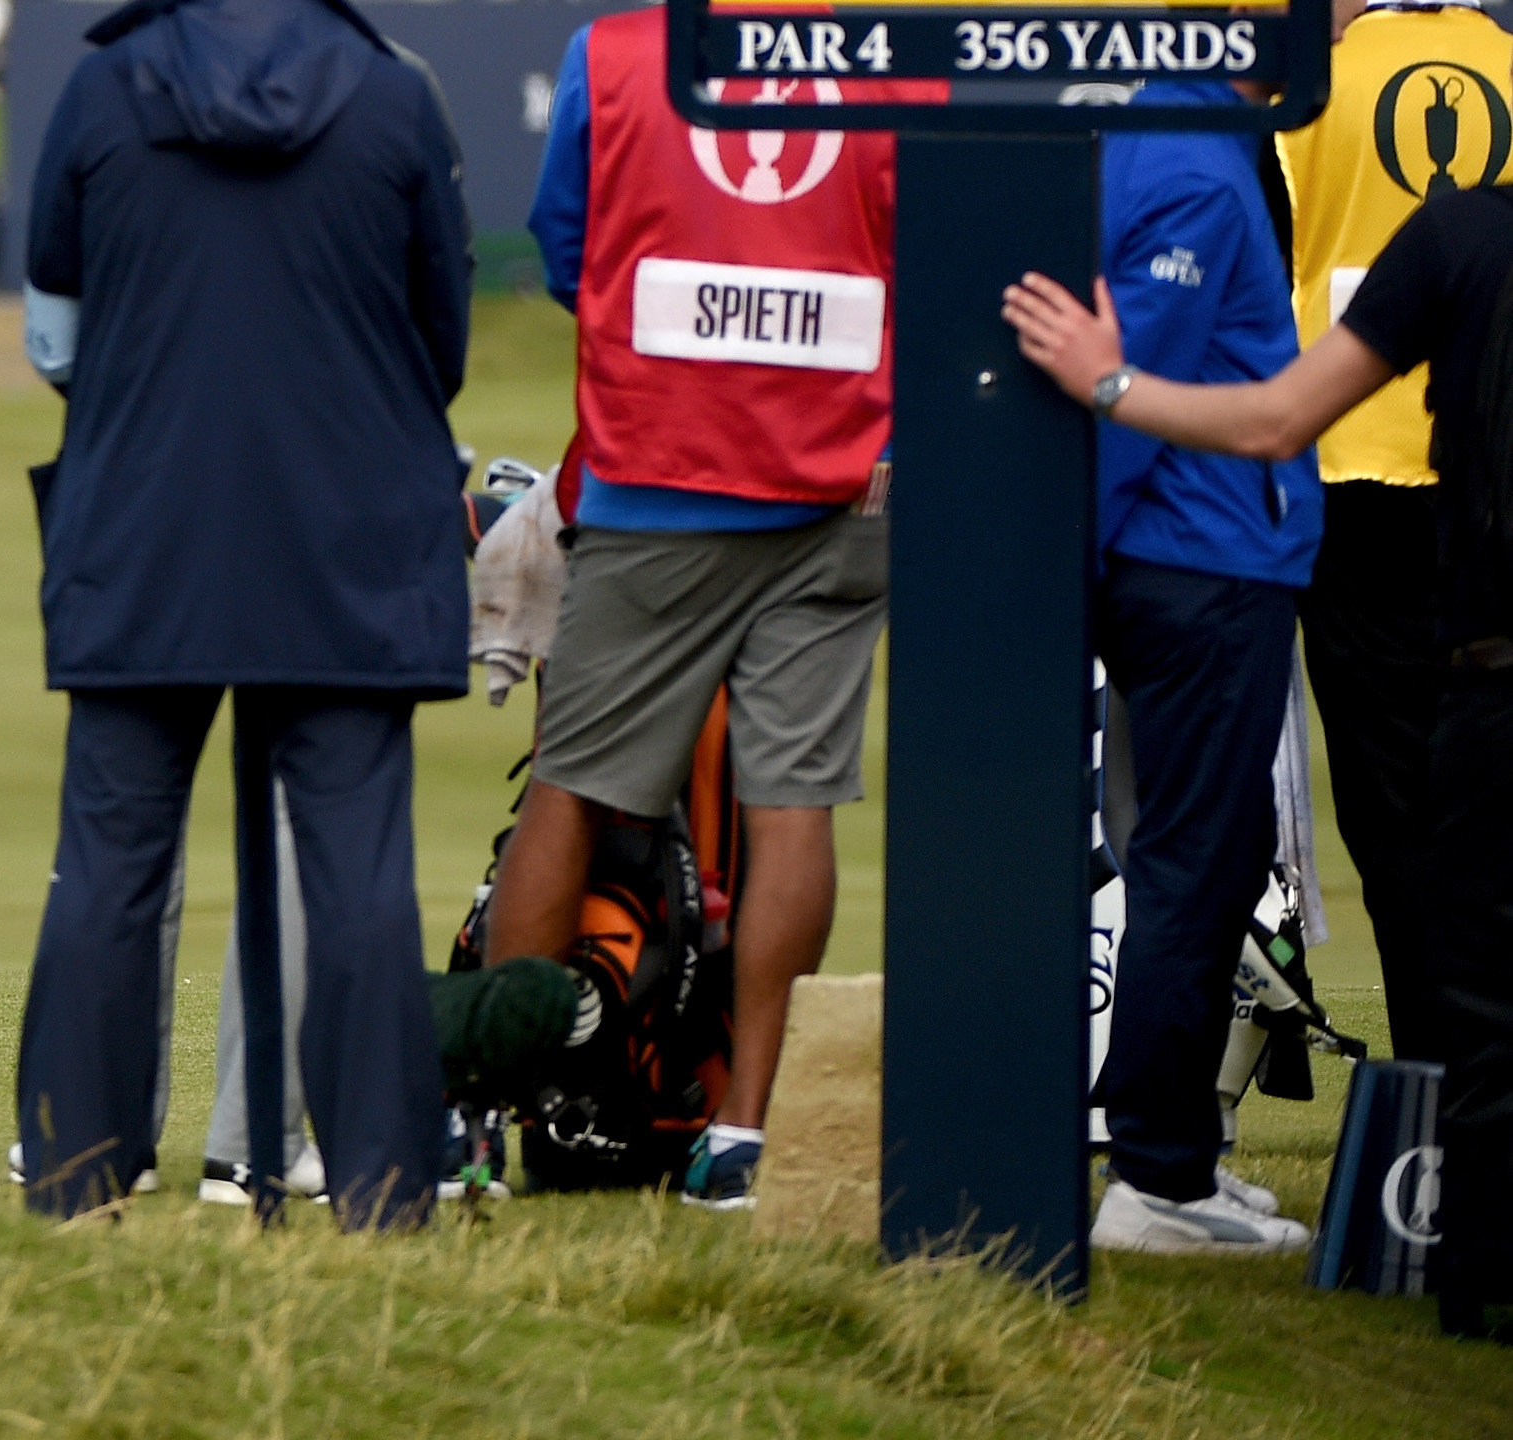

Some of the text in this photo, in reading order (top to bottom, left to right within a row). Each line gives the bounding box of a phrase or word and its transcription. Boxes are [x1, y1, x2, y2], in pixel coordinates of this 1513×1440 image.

[737, 20, 1257, 72] PAR 4 356 YARDS
[695, 282, 822, 346] SPIETH
